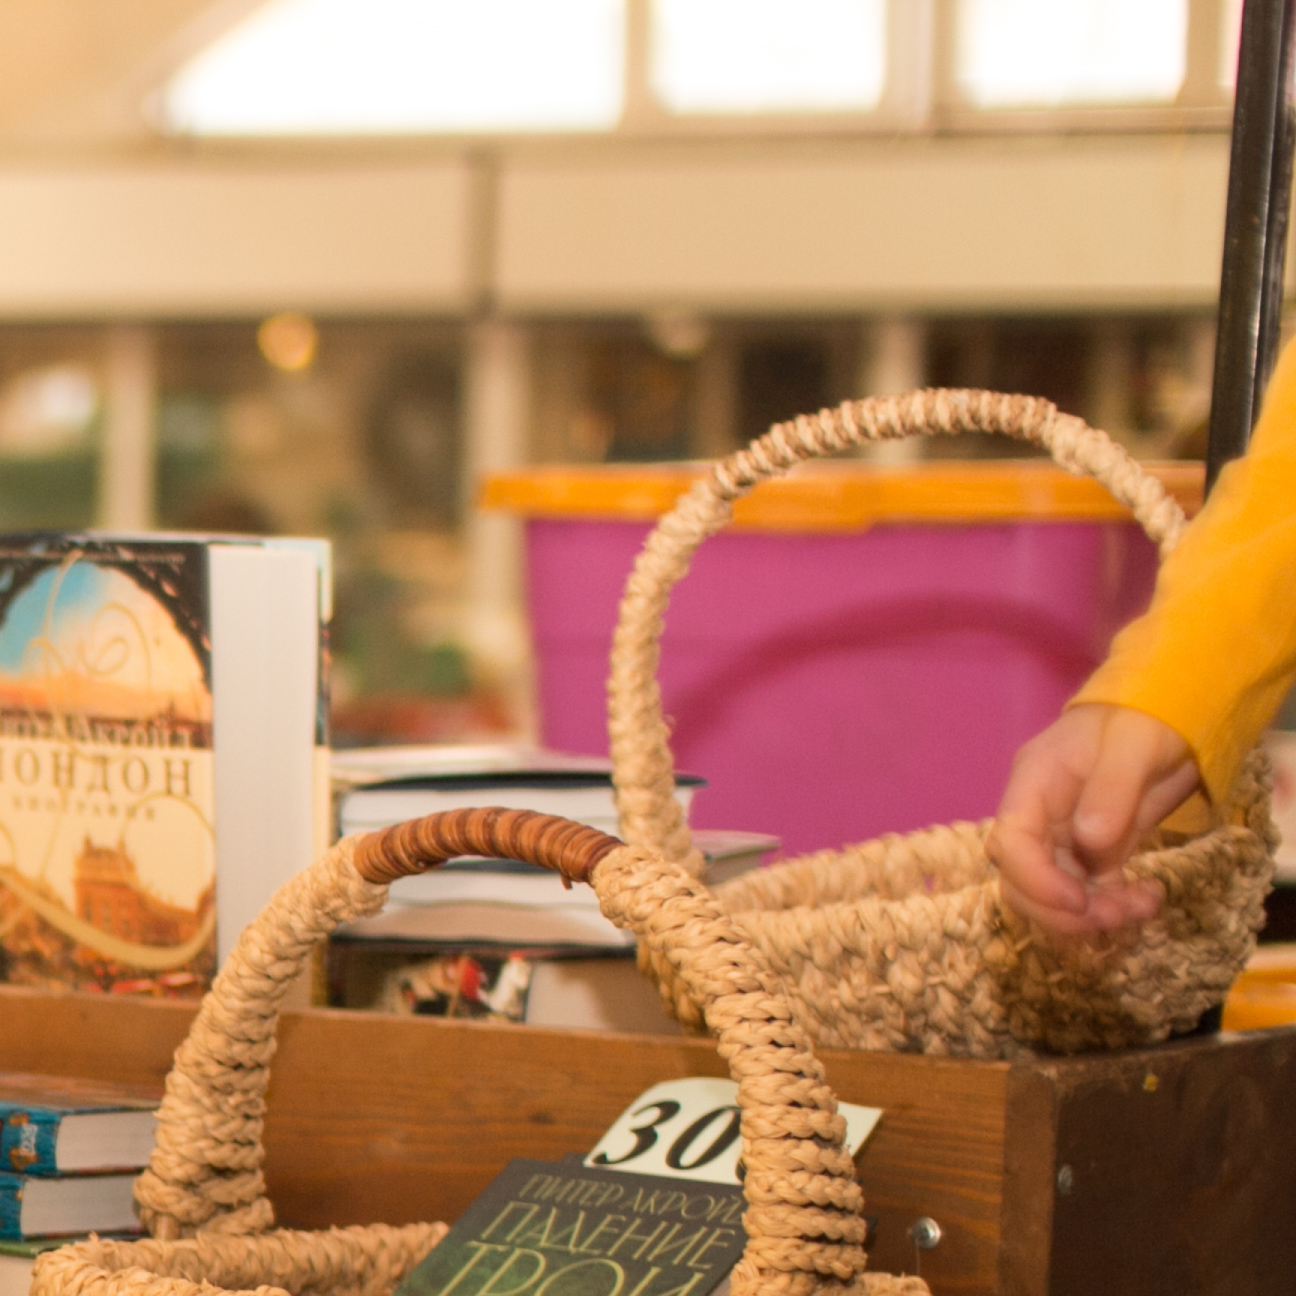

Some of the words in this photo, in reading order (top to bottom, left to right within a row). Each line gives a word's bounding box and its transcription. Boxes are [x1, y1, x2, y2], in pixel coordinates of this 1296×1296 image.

[592, 1098, 744, 1185] 30
[518, 1172, 626, 1208] ПИТЕР
[479, 1200, 737, 1271] ПАДЕНИЕ
